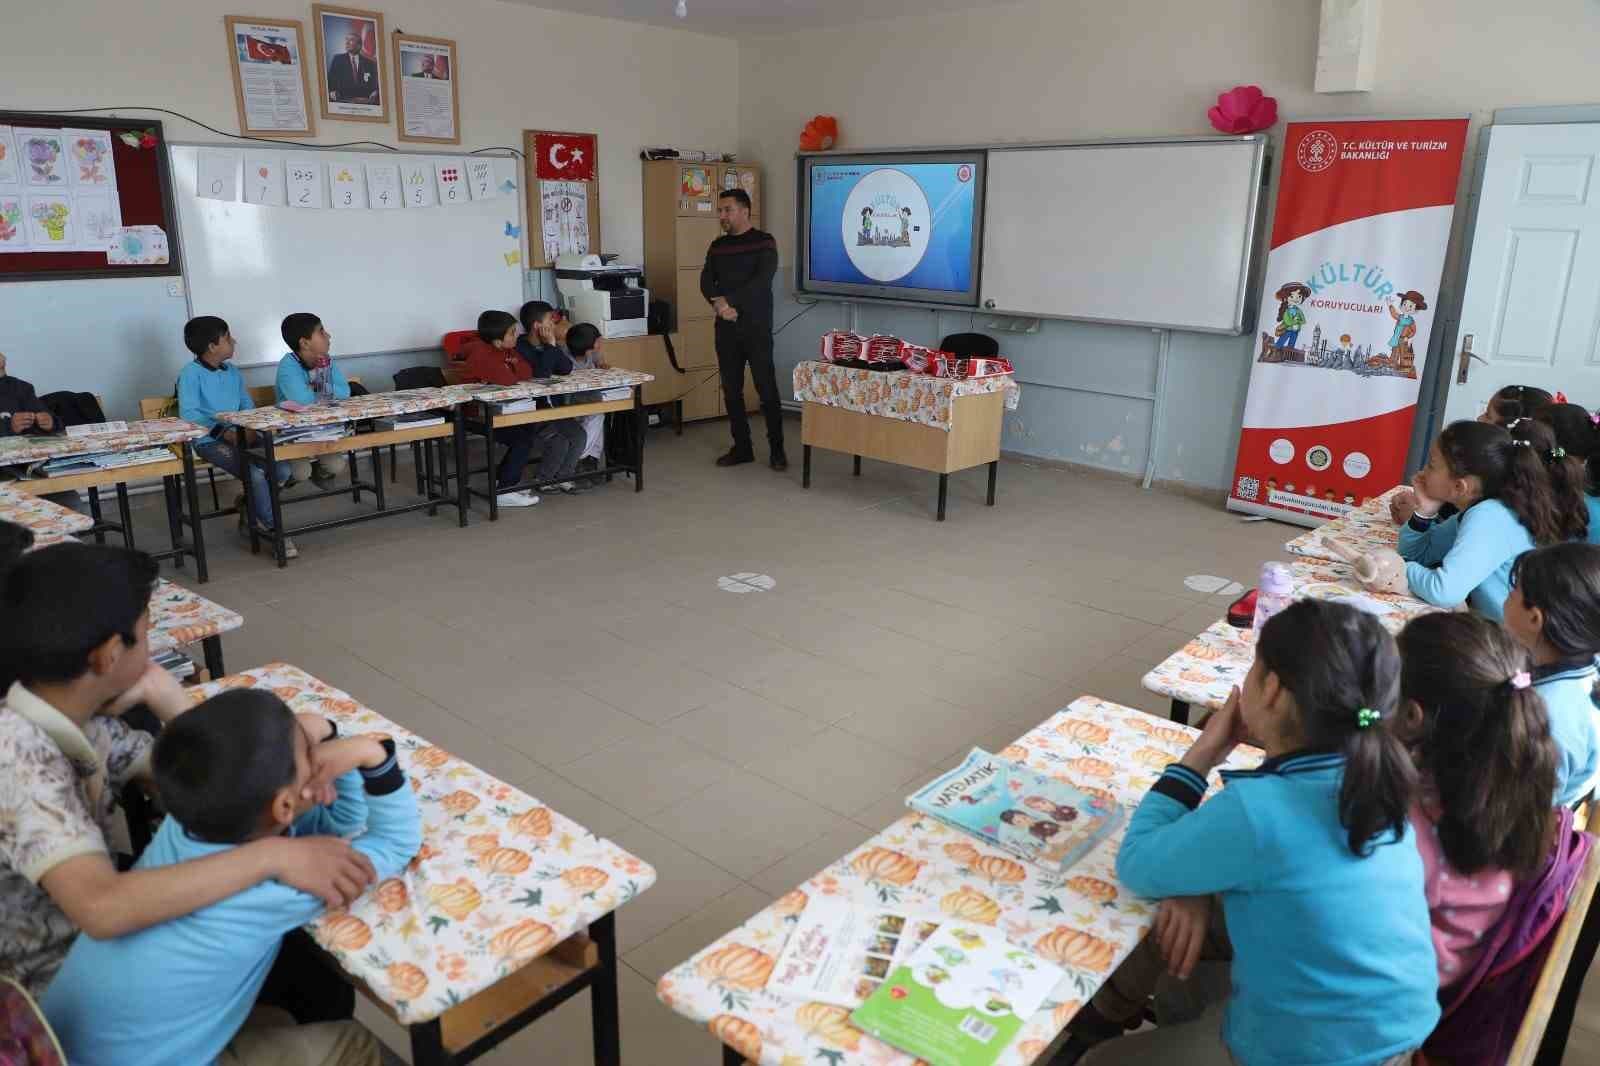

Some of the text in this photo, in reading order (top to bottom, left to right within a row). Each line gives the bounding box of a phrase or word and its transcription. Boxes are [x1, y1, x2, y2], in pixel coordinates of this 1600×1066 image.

[1342, 139, 1447, 150] T.C. KÜLTÜR VE TURİZM
[1340, 150, 1390, 160] BAKANLIĞI
[299, 188, 311, 203] 2
[415, 189, 423, 204] 5
[448, 186, 456, 200] 6
[479, 183, 488, 196] 7
[343, 191, 352, 205] 3
[379, 190, 388, 205] 4
[1306, 262, 1393, 300] KÜLTÜR
[1310, 300, 1383, 313] KORUYUCULARI
